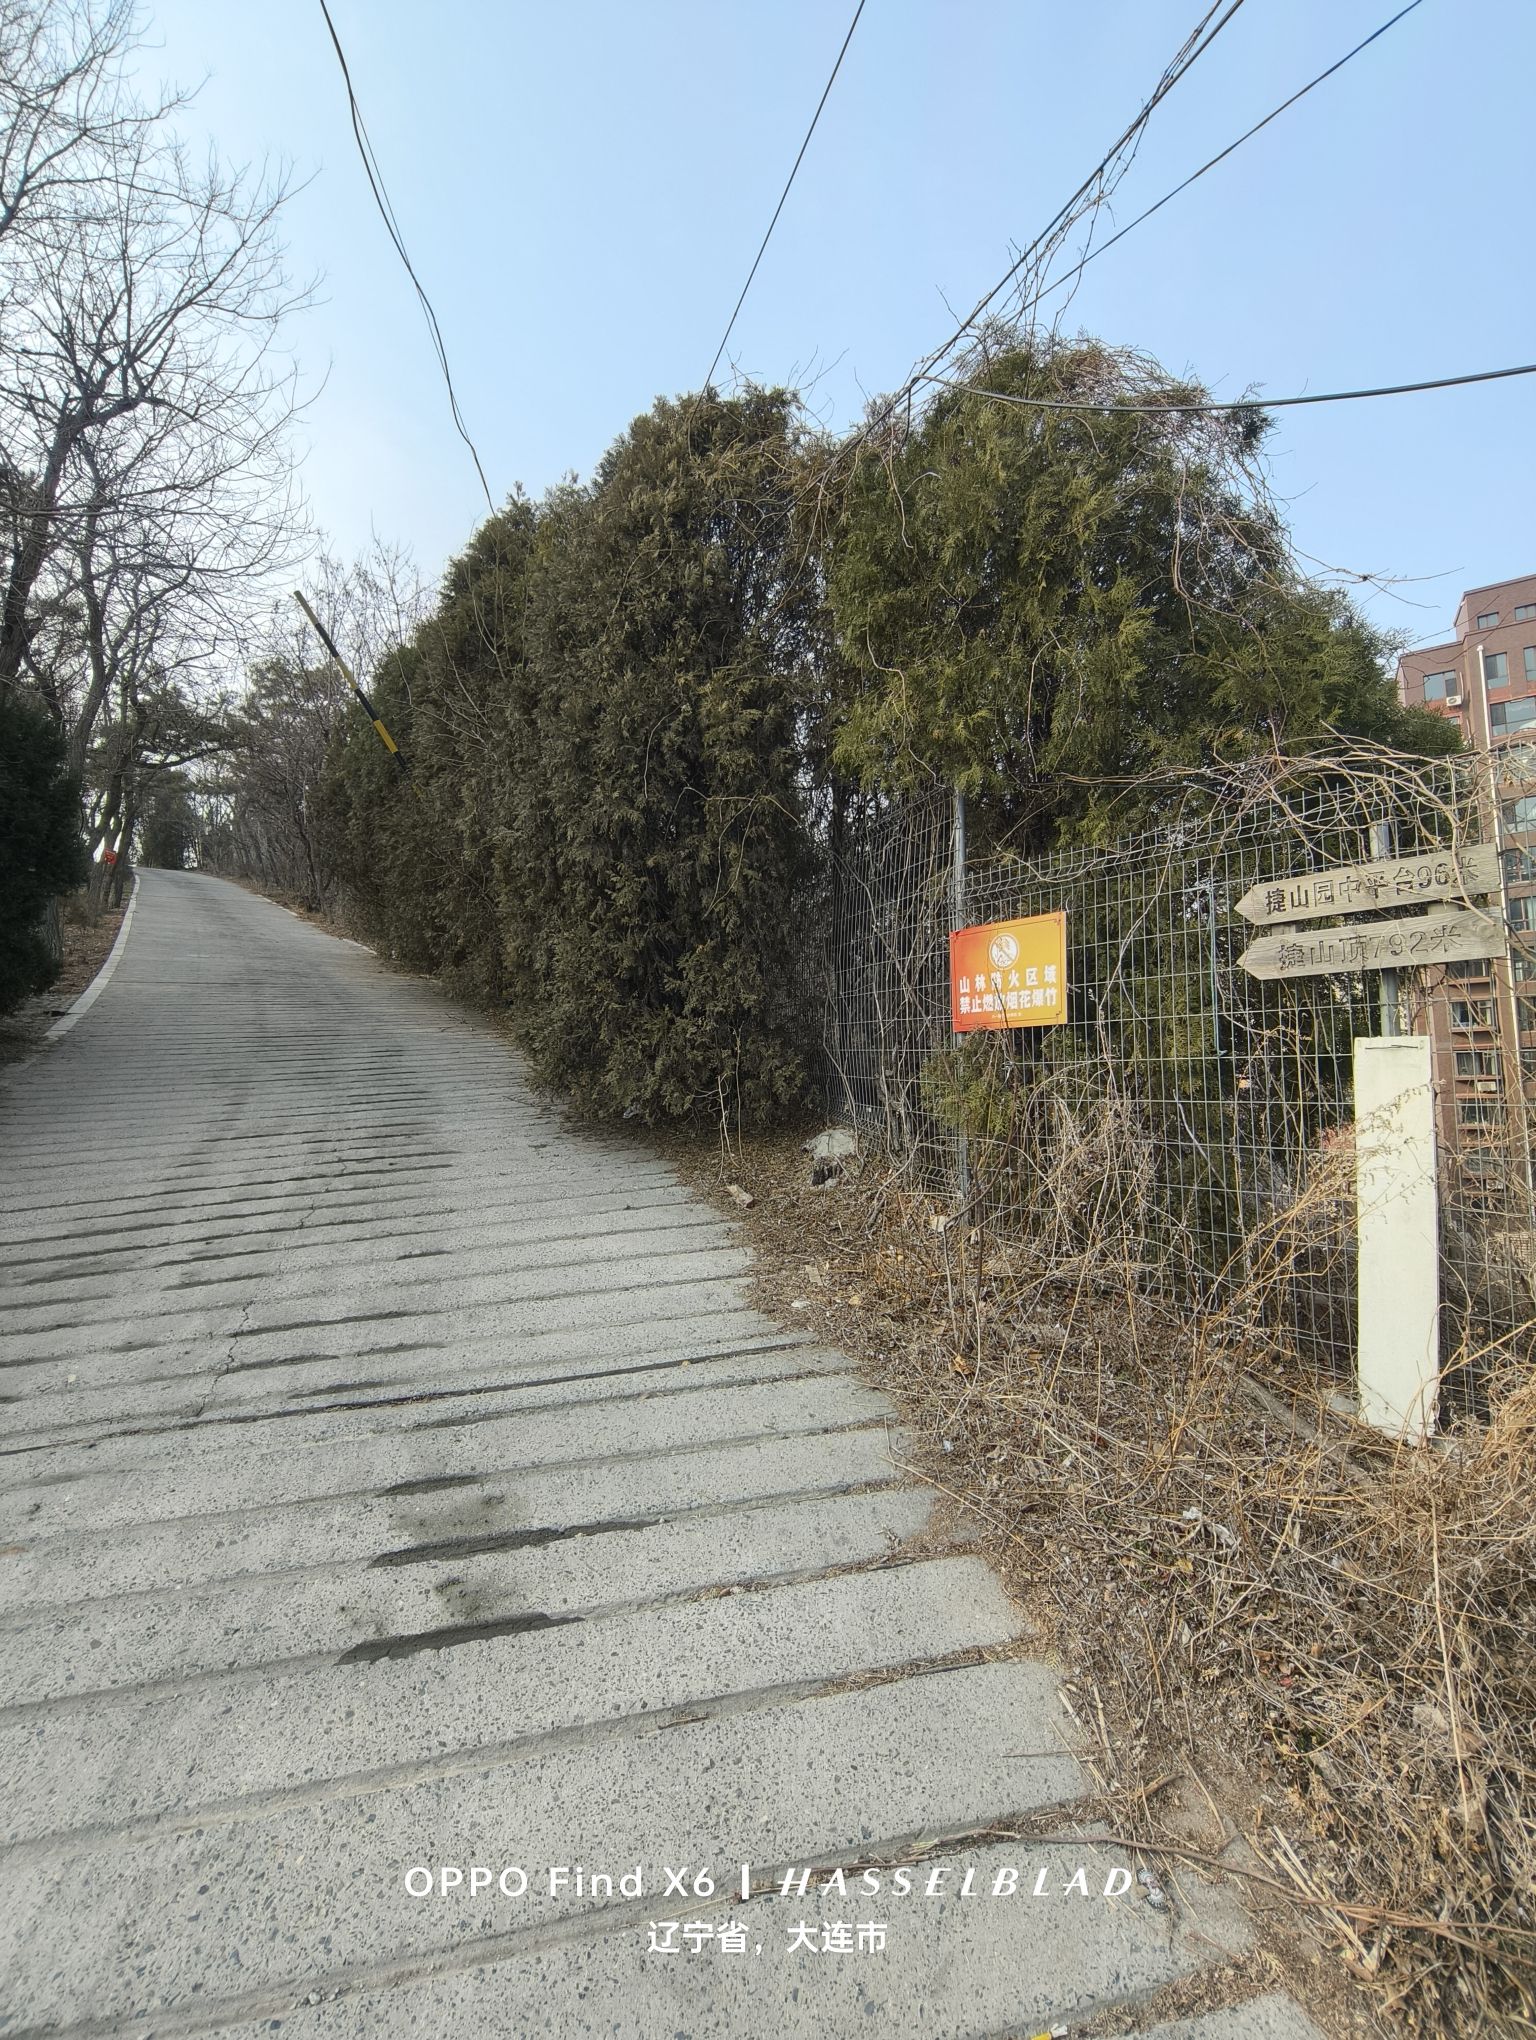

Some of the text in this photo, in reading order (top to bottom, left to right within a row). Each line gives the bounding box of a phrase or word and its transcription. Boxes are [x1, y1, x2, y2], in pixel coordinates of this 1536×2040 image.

[1265, 856, 1479, 915] 捷山园中平台96米
[1278, 924, 1463, 971] 捷山顶792米
[959, 964, 1057, 994] 山林防火区域
[959, 987, 1058, 1015] 禁止燃放烟花爆竹
